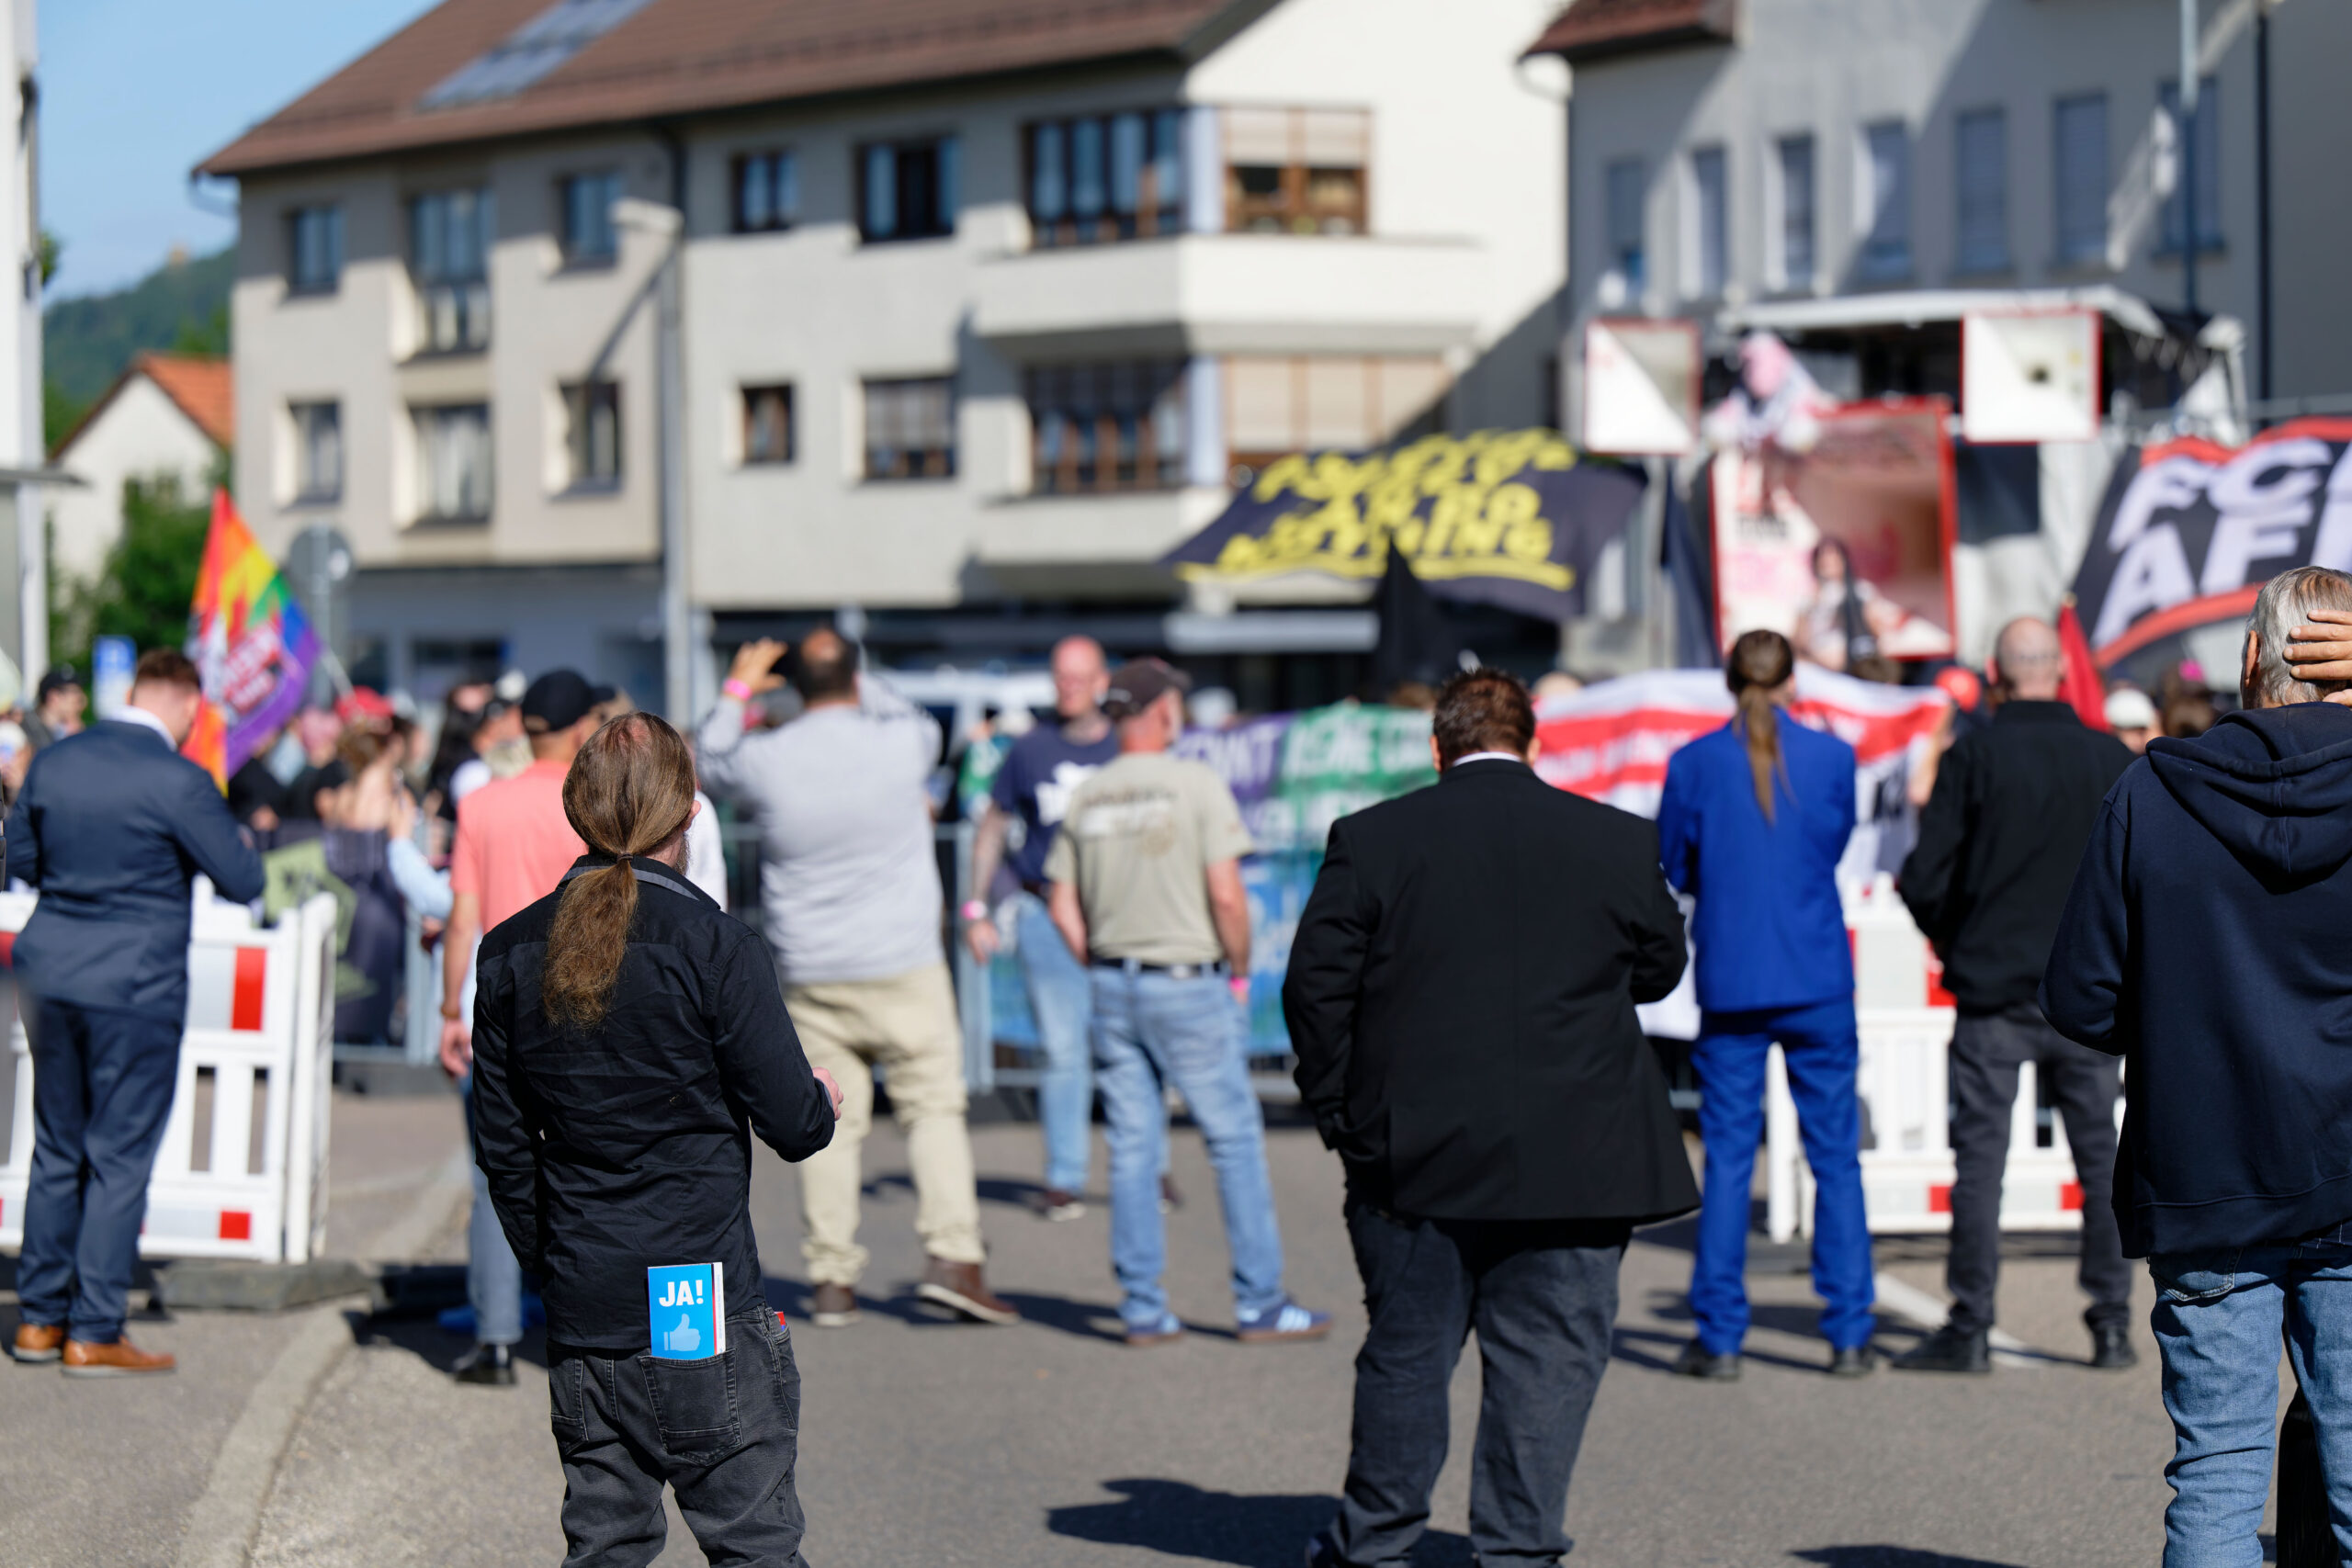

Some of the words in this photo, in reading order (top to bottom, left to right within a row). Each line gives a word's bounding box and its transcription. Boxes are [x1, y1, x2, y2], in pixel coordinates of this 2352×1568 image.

[2107, 436, 2352, 553] FC
[2089, 498, 2352, 647] AF
[659, 1280, 704, 1307] JA!
